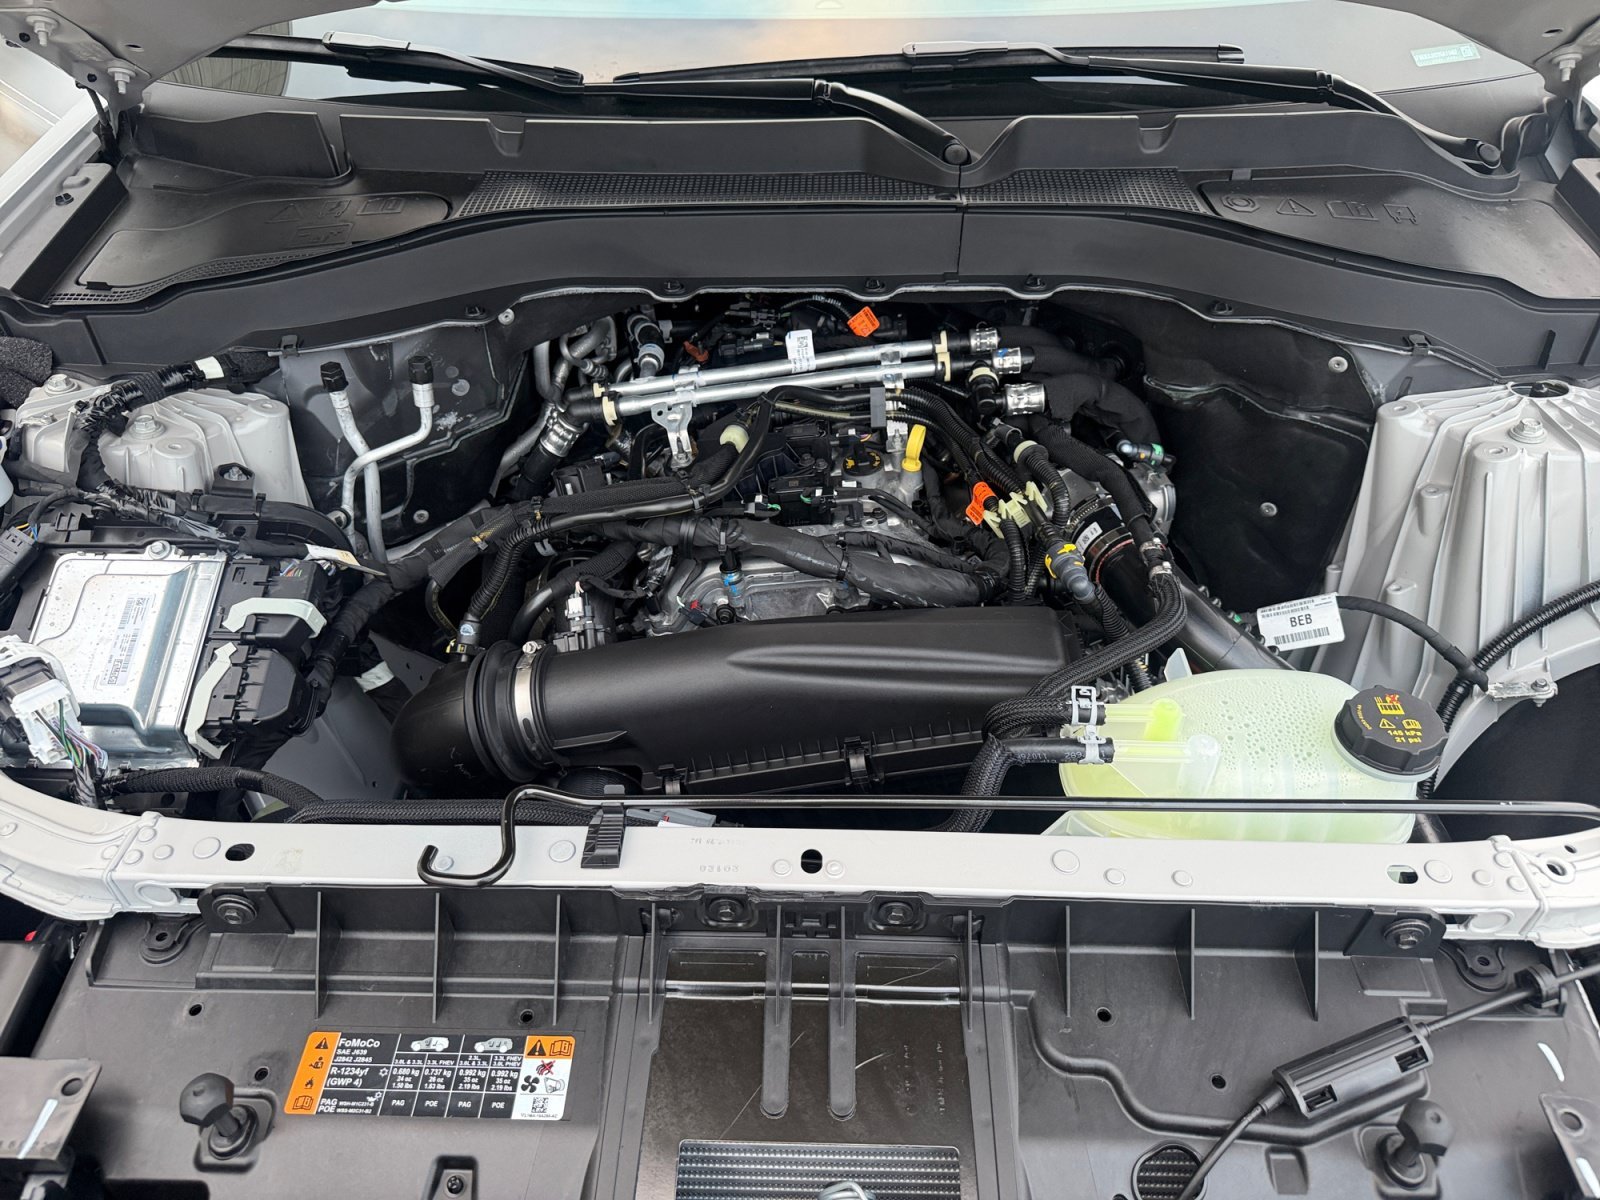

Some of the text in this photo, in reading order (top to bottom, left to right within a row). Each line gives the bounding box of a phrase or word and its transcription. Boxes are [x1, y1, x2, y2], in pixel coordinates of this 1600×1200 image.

[1289, 613, 1313, 628] BEB
[338, 1038, 381, 1048] FoMoCo
[330, 1067, 370, 1076] R-1234yf
[411, 1067, 421, 1077] kg
[424, 1068, 452, 1078] 0.737 kg
[459, 1068, 487, 1079] 0.992 kg
[491, 1069, 519, 1080] 0.992 kg
[327, 1077, 363, 1087] (GWP 4)
[391, 1099, 405, 1107] PAG
[491, 1101, 506, 1109] POE
[318, 1105, 336, 1113] POE
